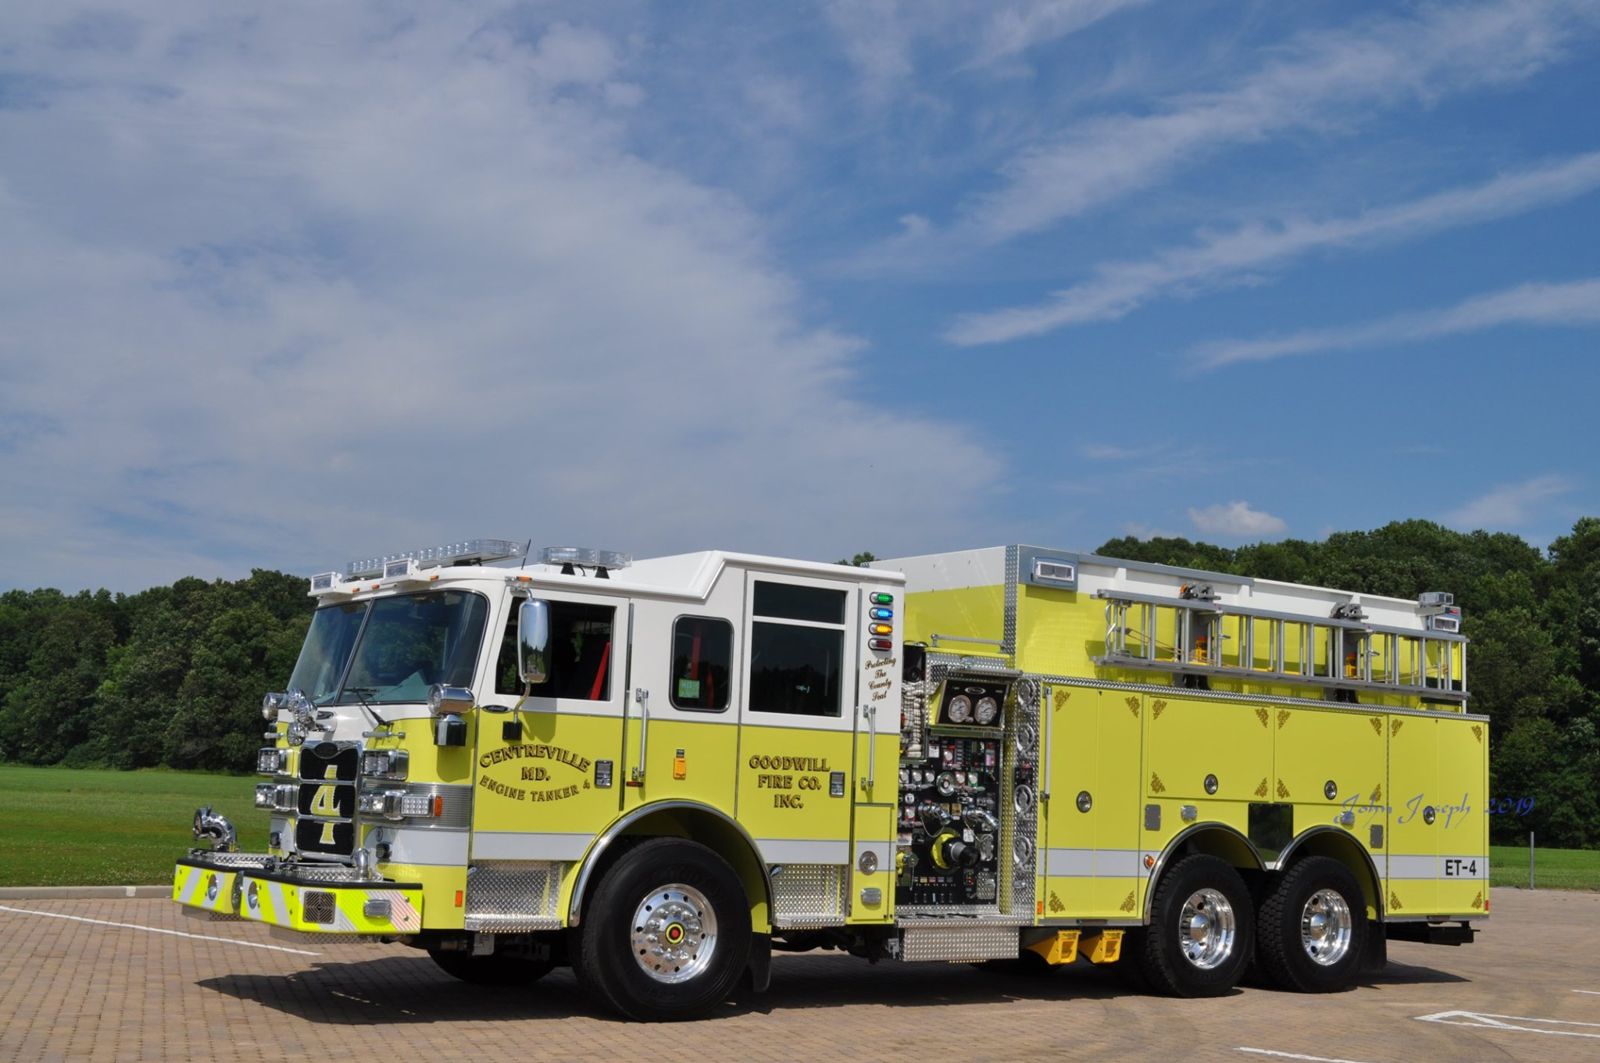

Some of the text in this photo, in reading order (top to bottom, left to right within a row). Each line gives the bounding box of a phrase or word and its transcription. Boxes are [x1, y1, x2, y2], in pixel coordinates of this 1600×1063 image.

[479, 744, 591, 773] CENTREVILLE
[749, 755, 830, 772] GOODWILL
[521, 766, 551, 781] MD.
[758, 774, 822, 790] FIRE CO.
[479, 775, 526, 801] ENGINE
[530, 784, 580, 802] TANKER
[310, 764, 341, 845] 4
[774, 794, 804, 809] INC.
[1445, 859, 1477, 876] ET-4
